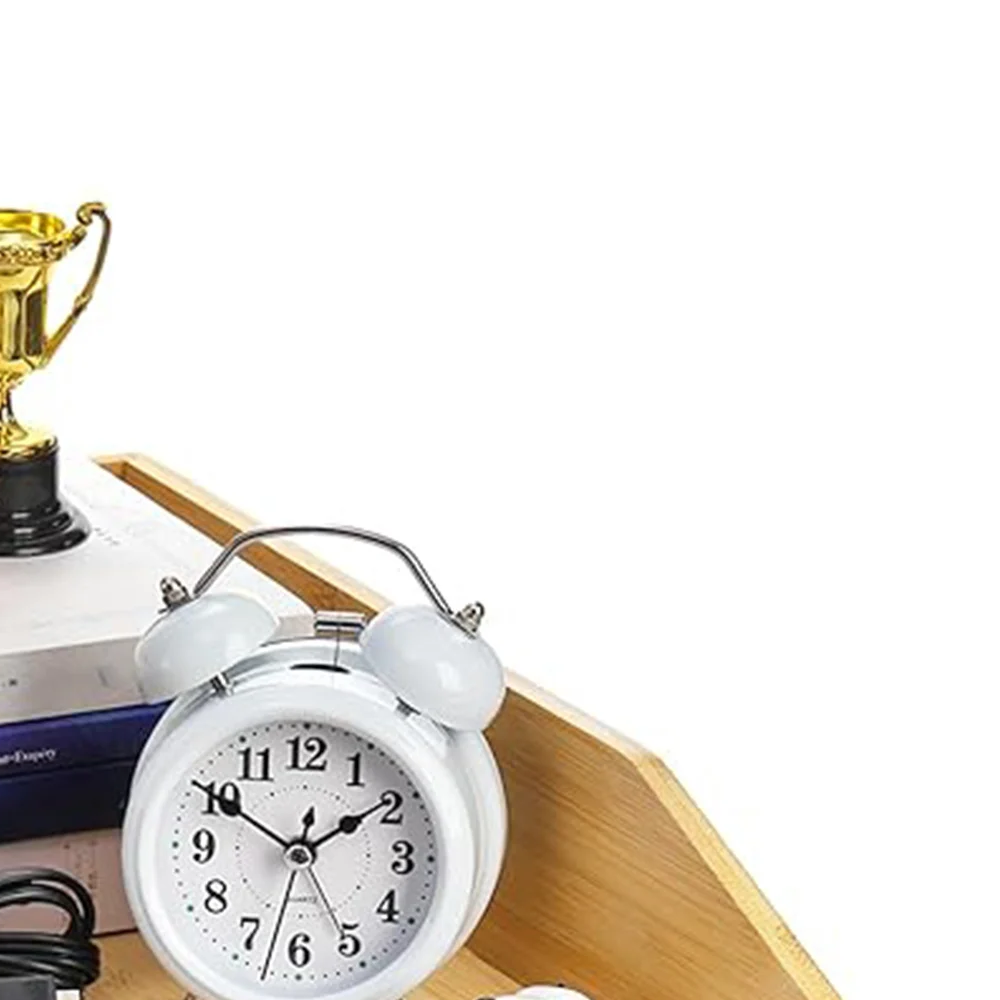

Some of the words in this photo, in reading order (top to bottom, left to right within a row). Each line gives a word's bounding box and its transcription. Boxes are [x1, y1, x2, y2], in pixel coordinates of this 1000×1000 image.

[237, 747, 274, 782] 11
[286, 737, 328, 772] 12
[346, 752, 366, 787] 1
[202, 782, 241, 817] 10
[380, 790, 403, 825] 2
[192, 829, 215, 864] 9
[391, 840, 415, 875] 3
[204, 878, 228, 914] 8
[375, 889, 400, 923] 4
[240, 917, 261, 951] 7
[287, 932, 312, 968] 6
[337, 922, 362, 958] 5
